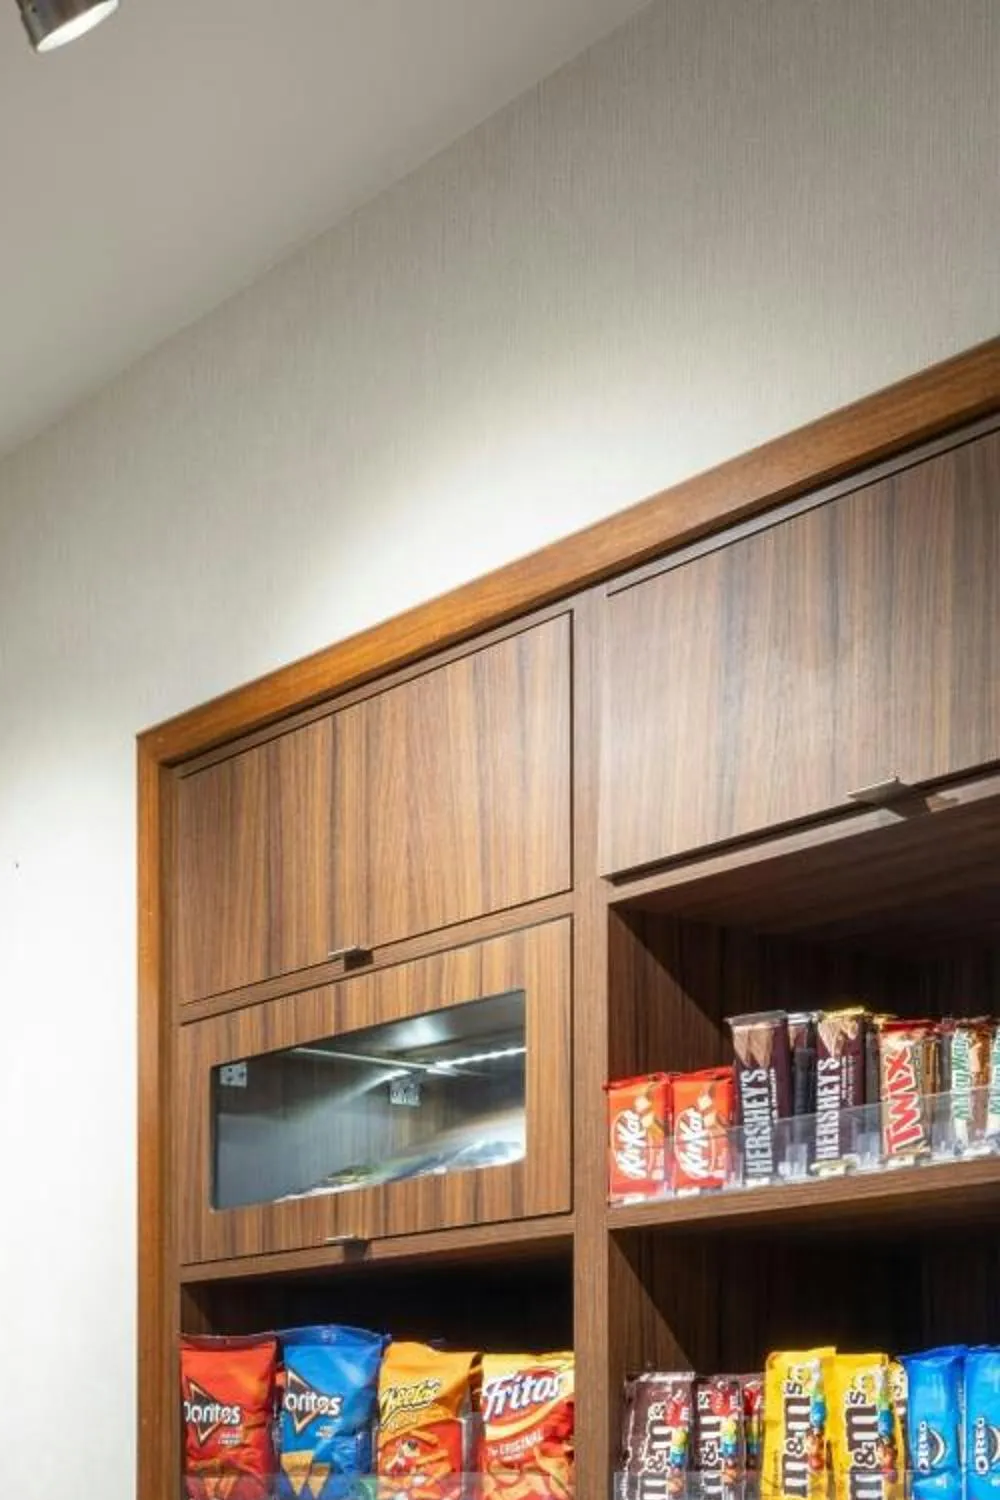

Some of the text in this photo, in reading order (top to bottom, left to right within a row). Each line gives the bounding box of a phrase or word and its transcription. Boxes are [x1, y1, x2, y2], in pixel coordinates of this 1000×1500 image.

[740, 1069, 773, 1174] HERSHEY'S
[815, 1057, 841, 1160] HERSHEY'S
[885, 1047, 923, 1154] TWIX
[482, 1372, 564, 1422] Fritos
